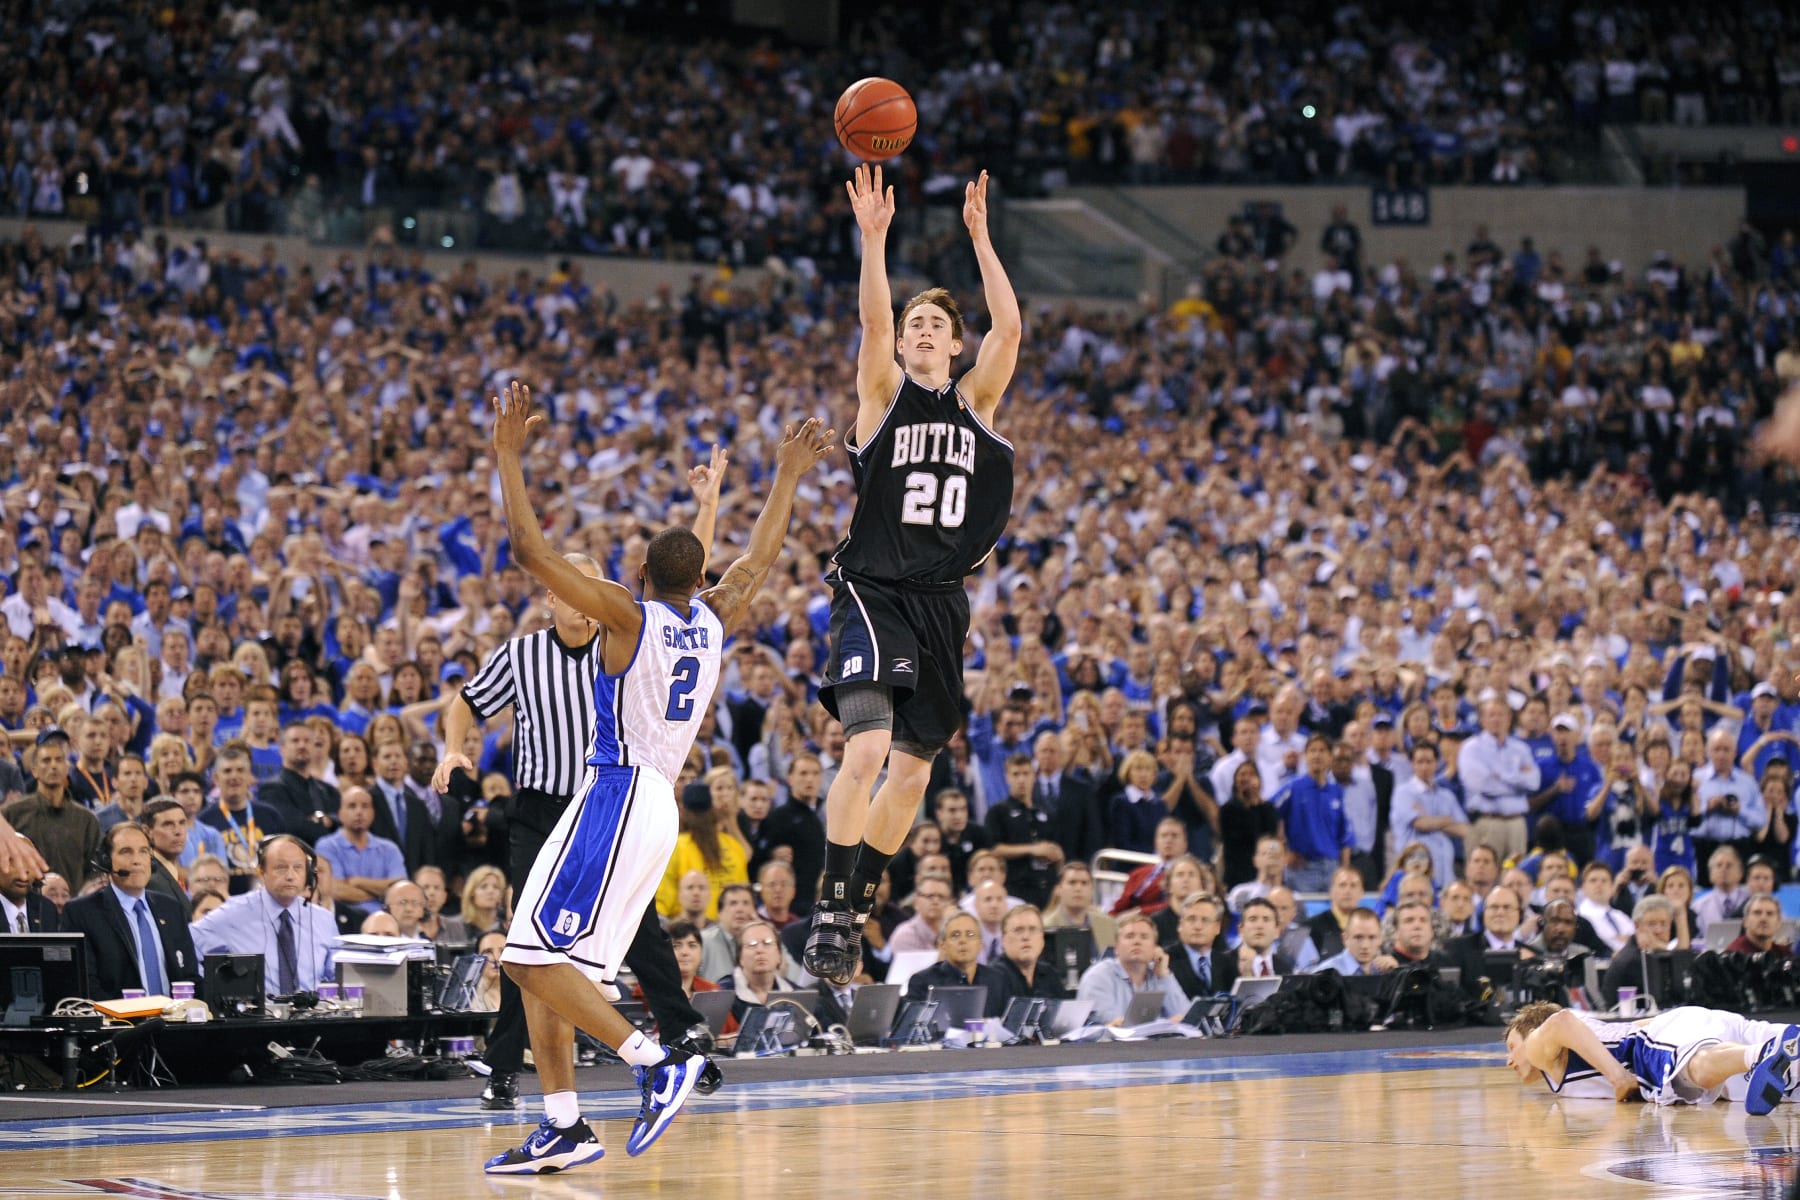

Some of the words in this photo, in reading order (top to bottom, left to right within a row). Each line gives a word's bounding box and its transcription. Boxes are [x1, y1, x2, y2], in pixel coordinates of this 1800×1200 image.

[891, 423, 976, 475] BUTLER
[901, 471, 967, 528] 20
[665, 656, 700, 721] 2
[842, 656, 863, 678] 20
